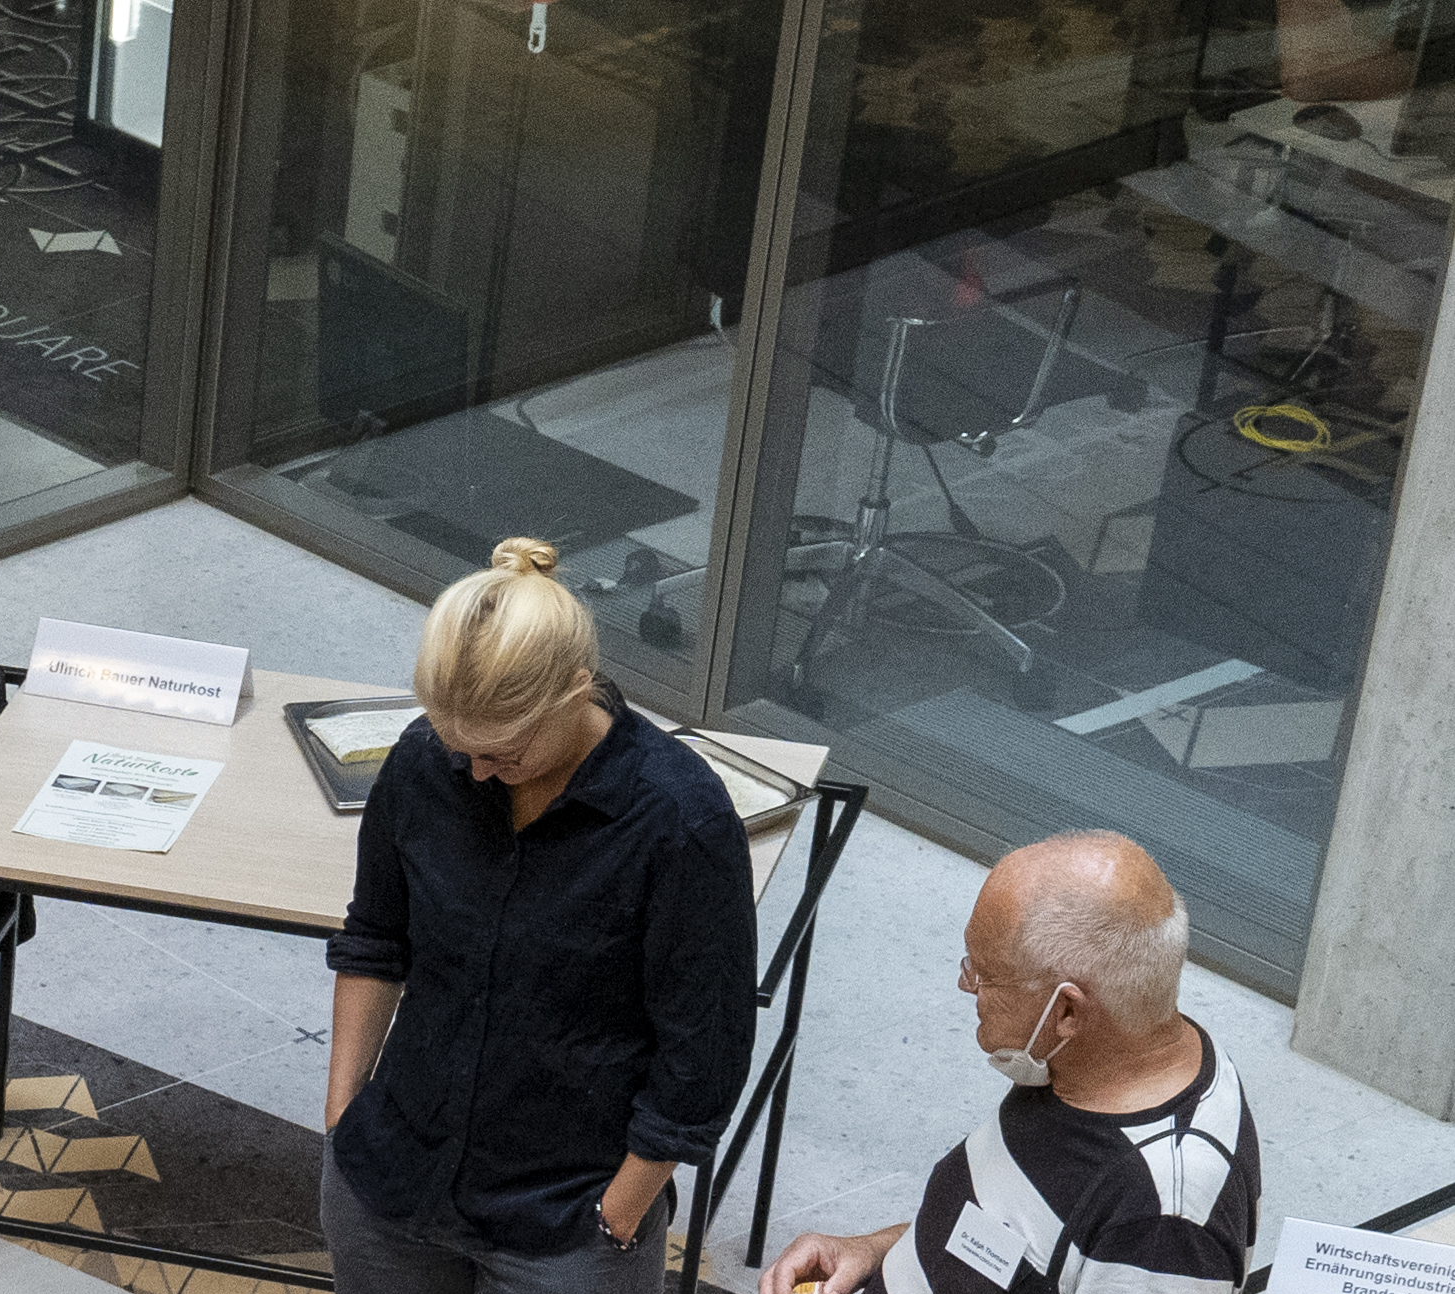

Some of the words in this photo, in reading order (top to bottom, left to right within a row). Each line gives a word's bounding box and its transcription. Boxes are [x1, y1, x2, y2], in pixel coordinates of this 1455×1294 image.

[99, 667, 145, 686] Bauer
[147, 675, 222, 699] Naturkost
[82, 752, 194, 777] Naturkost
